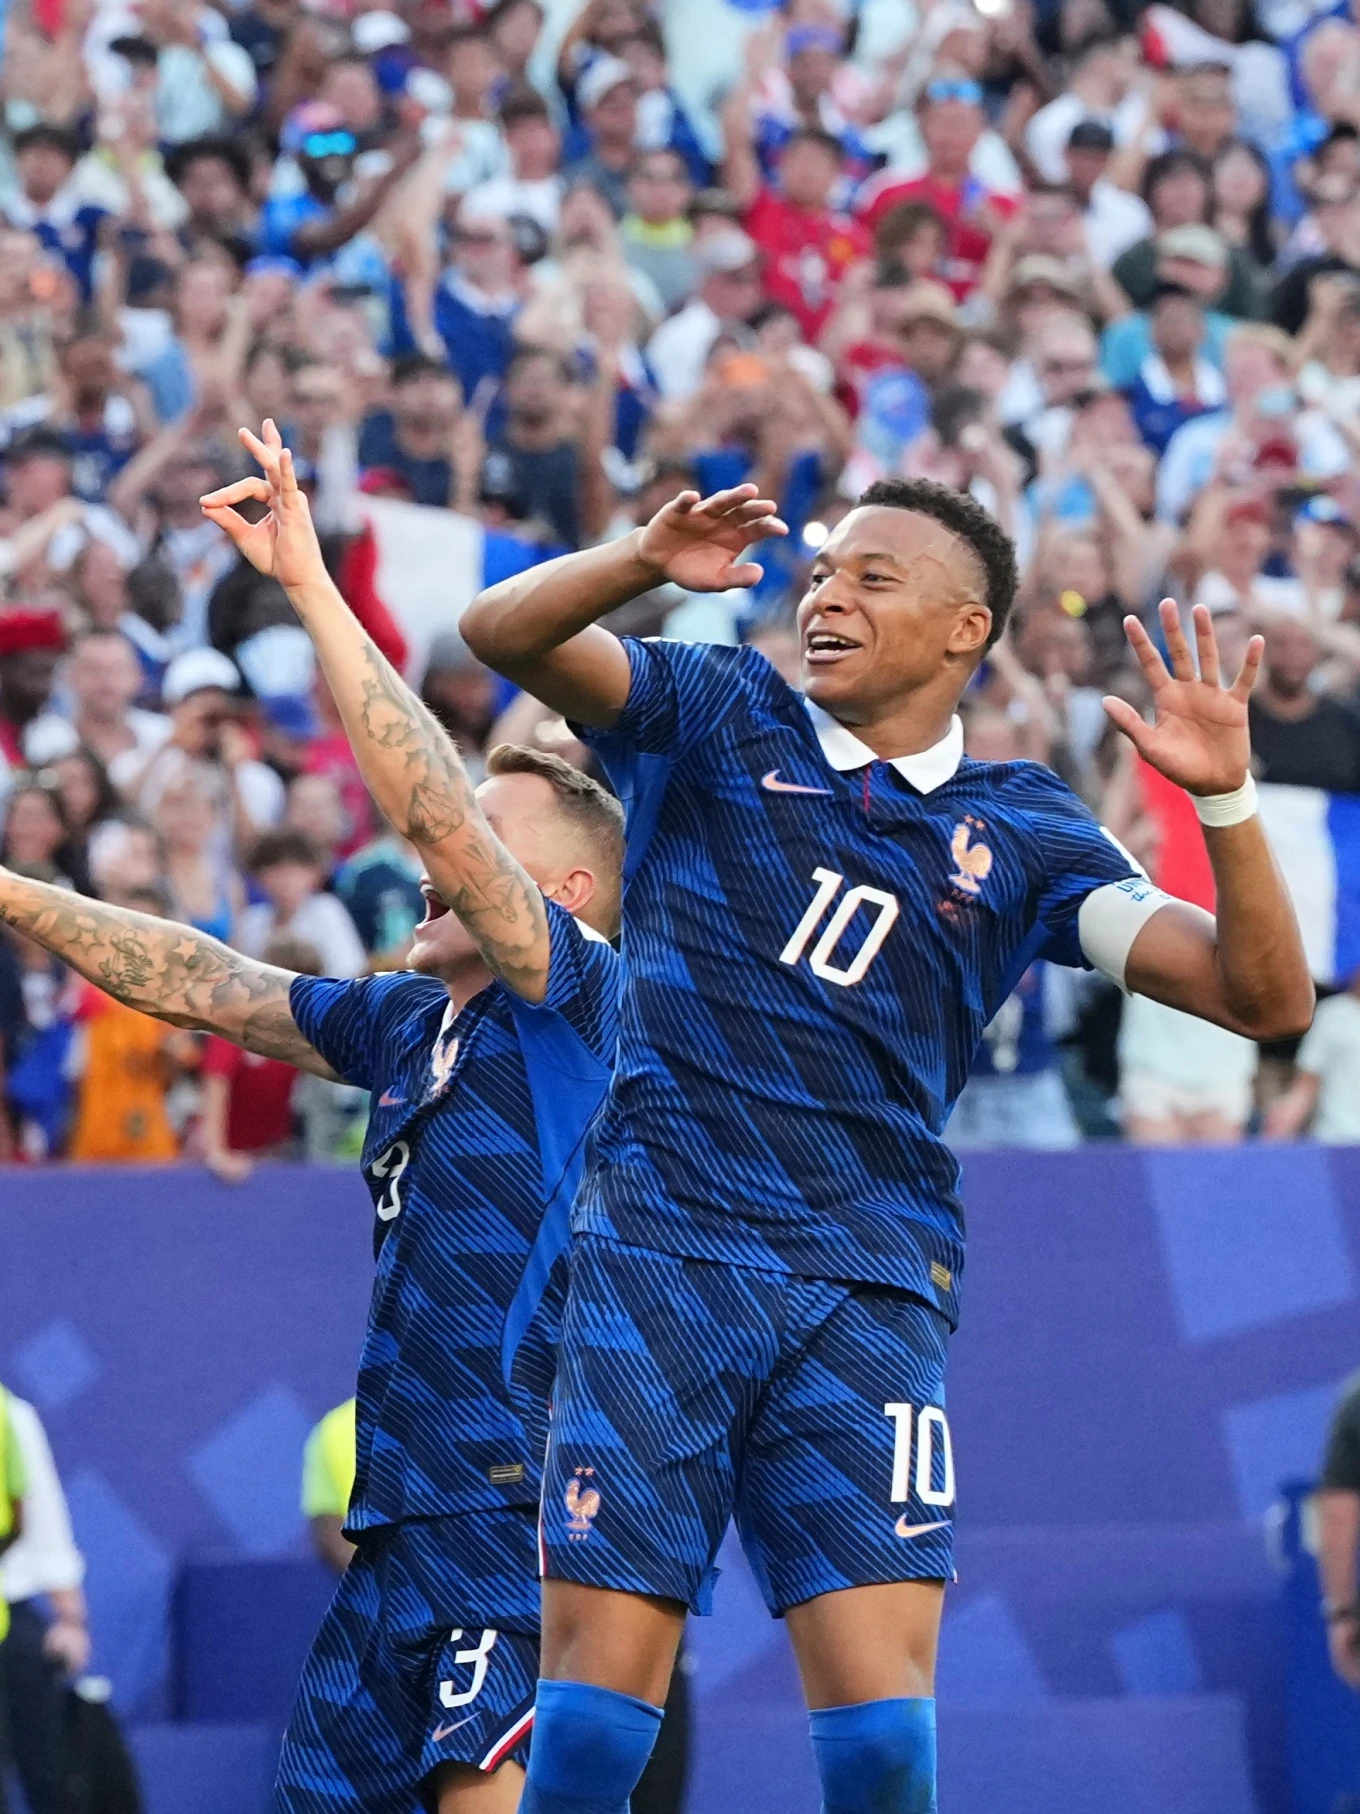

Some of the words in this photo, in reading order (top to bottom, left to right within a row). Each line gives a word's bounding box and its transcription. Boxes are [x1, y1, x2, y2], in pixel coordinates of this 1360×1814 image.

[779, 866, 900, 987] 10
[884, 1402, 956, 1507] 10
[439, 1628, 498, 1709] 3
